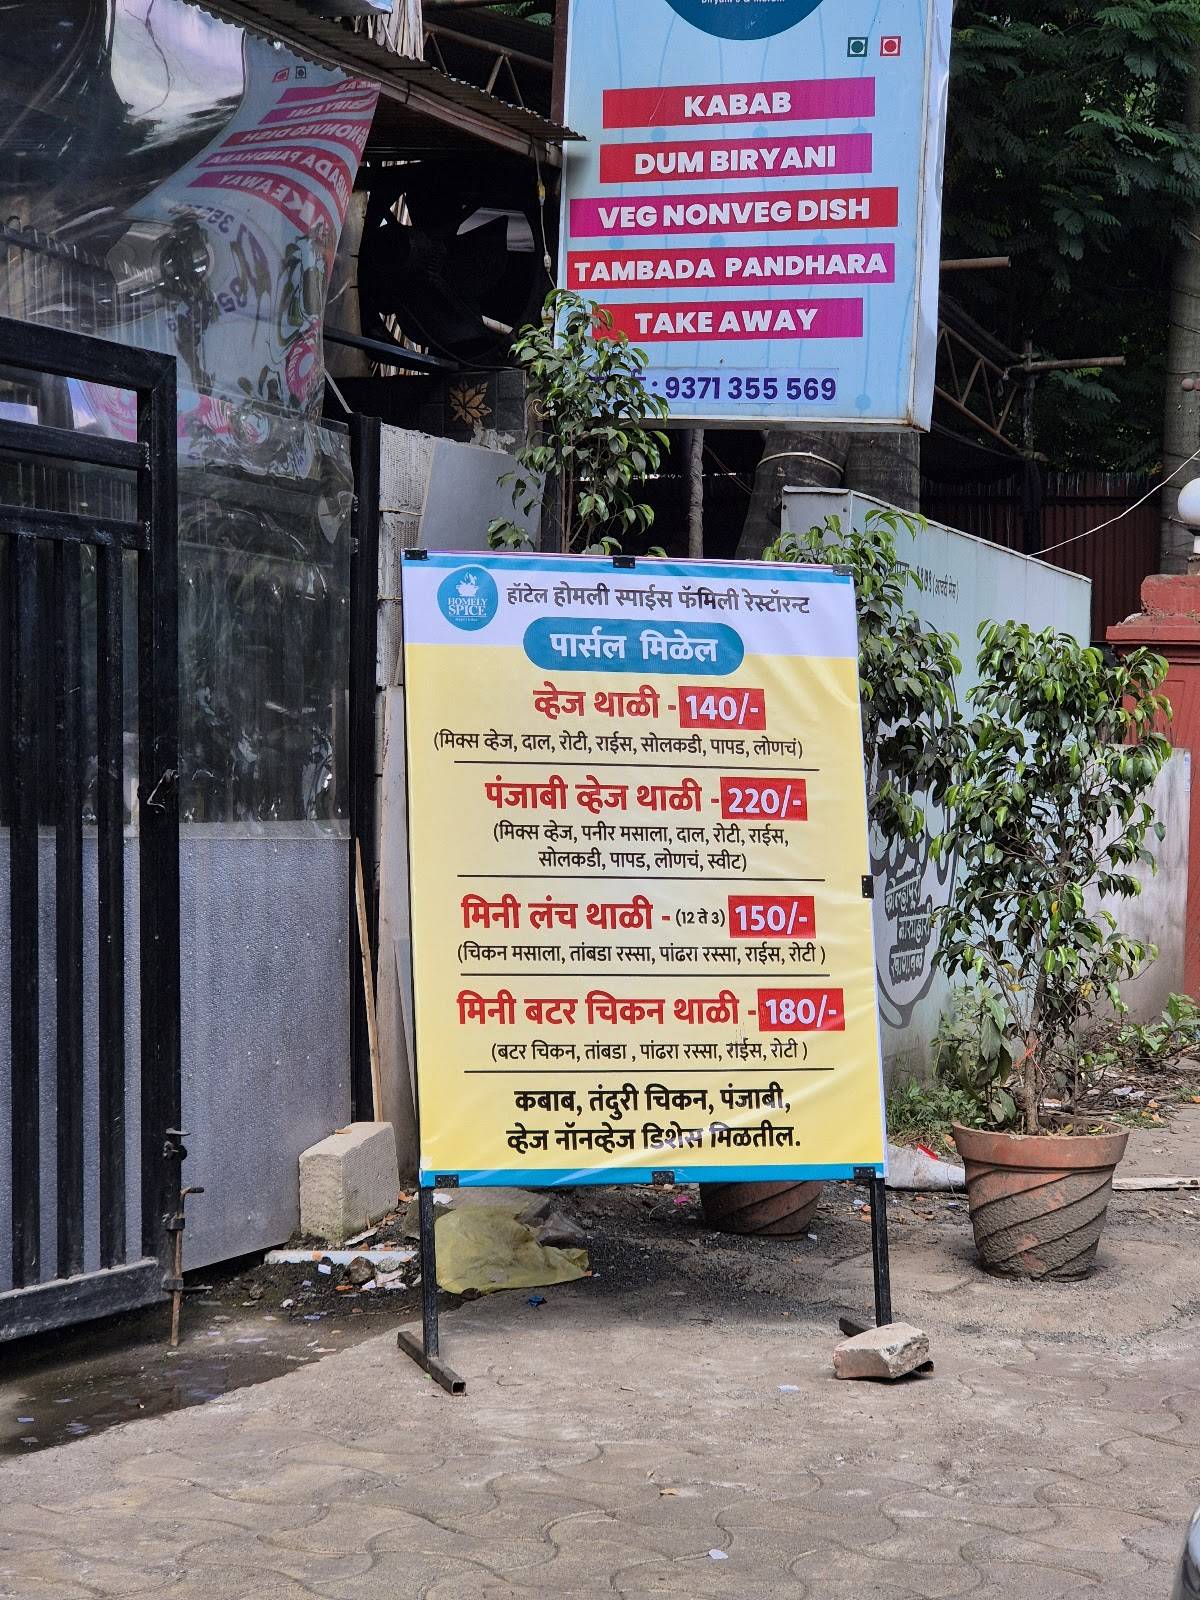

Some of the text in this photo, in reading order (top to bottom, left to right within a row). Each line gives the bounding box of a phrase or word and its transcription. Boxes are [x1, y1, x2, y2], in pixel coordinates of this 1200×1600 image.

[685, 92, 791, 117] KABAB
[635, 146, 835, 174] DUM BIRYANI
[598, 198, 869, 228] VEG NONVEG DISH
[575, 253, 887, 281] TAMBADA PANDHARA
[635, 309, 818, 333] TAKE AWAY
[665, 377, 720, 399] 9371
[728, 377, 778, 399] 355
[787, 378, 836, 400] 569
[447, 597, 488, 606] HOMELY
[448, 605, 487, 616] SPICE
[507, 581, 810, 613] हॉटेल होमली स्पाईस फॅमिली रेस्टॉरन्ट
[549, 625, 719, 662] पार्सल मिळेल
[533, 681, 586, 720] व्हेज
[594, 684, 660, 718] थाळी
[686, 693, 758, 724] 140/-
[434, 728, 803, 759] (मिक्स व्हेज, दाल, रोटी, राईस, सोलकडी, पापड, लोणचं)
[484, 775, 568, 809] पंजाबी
[575, 775, 629, 814] व्हेज
[637, 778, 702, 812] थाळी
[728, 785, 801, 817] 220/-
[494, 819, 788, 847] (मिक्स व्हेज, पनीर मसाला, दाल, रोटी, राईस,
[538, 846, 747, 872] सोलकडी, पापड, लोणचं, स्वीट)
[461, 893, 521, 928] मिनी
[528, 895, 578, 929] लंच
[586, 895, 653, 929] थाळी
[676, 908, 695, 927] (12
[697, 908, 708, 924] ते
[712, 909, 725, 927] 3)
[736, 902, 807, 934] 150/-
[458, 941, 508, 964] (चिकन
[511, 946, 565, 964] मसाला,
[569, 942, 612, 961] तांबडा
[616, 946, 655, 965] रस्सा,
[659, 942, 699, 962] पांढरा
[702, 947, 741, 965] रस्सा,
[744, 941, 785, 965] राईस,
[788, 942, 816, 962] रोटी
[456, 989, 517, 1024] मिनी
[524, 999, 578, 1024] बटर
[585, 990, 666, 1024] चिकन
[674, 990, 740, 1024] थाळी
[766, 995, 836, 1027] 180/-
[492, 1043, 527, 1062] (बटर
[531, 1039, 580, 1063] चिकन,
[584, 1040, 627, 1059] तांबडा
[639, 1040, 679, 1059] पांढरा
[683, 1044, 722, 1062] रस्सा,
[726, 1038, 767, 1061] राईस,
[770, 1038, 798, 1058] रोटी
[514, 1081, 790, 1121] कबाब, तंदुरी चिकन, पंजाबी,
[506, 1119, 800, 1154] व्हेज नॉनव्हेज डिशेस मिळतील.
